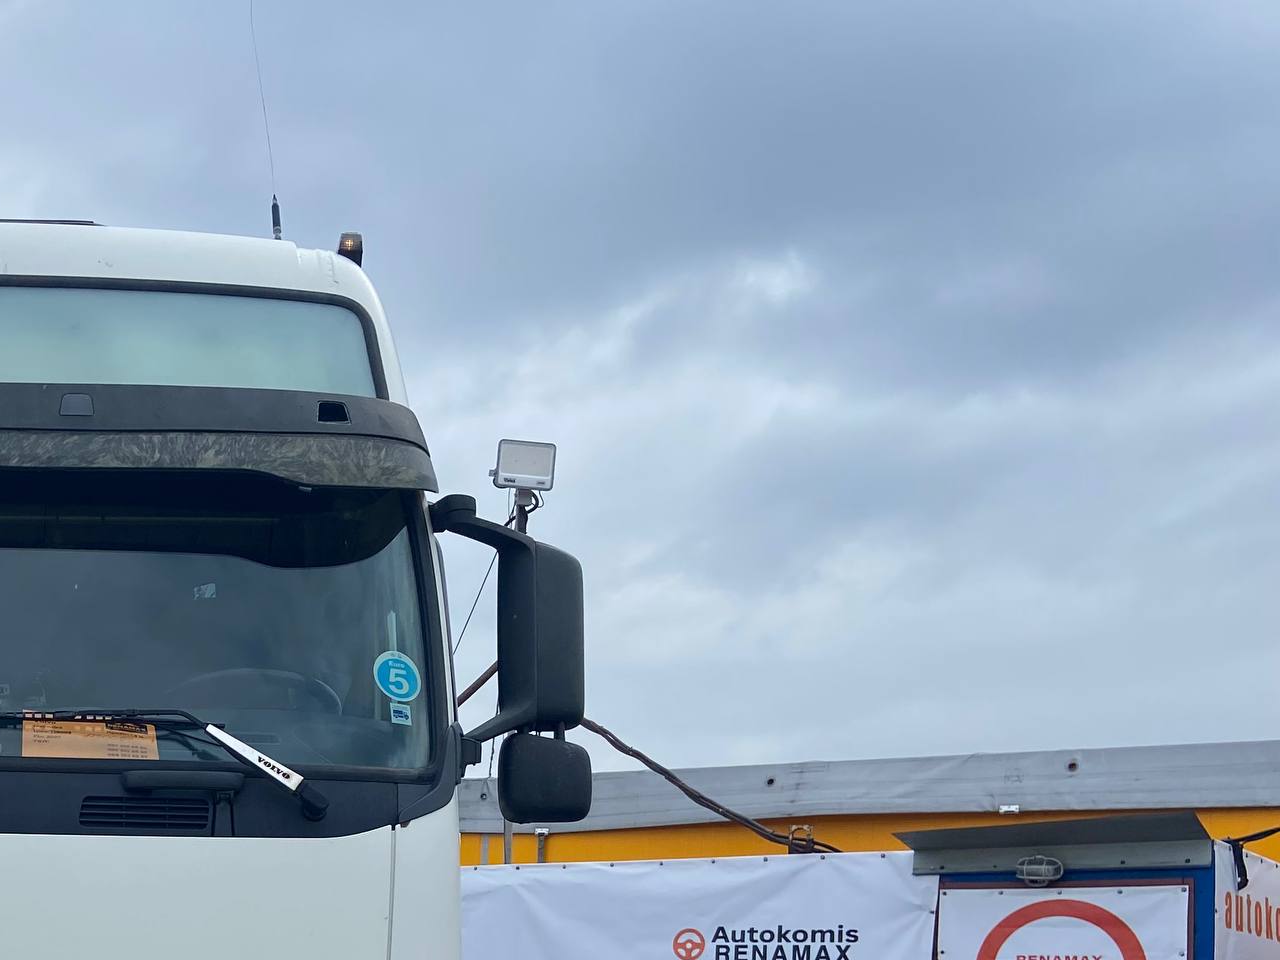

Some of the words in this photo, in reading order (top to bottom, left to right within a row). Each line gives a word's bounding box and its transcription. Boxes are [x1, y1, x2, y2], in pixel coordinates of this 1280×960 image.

[389, 668, 409, 694] 5
[257, 755, 291, 780] VOLVO
[711, 925, 859, 943] Autokomis
